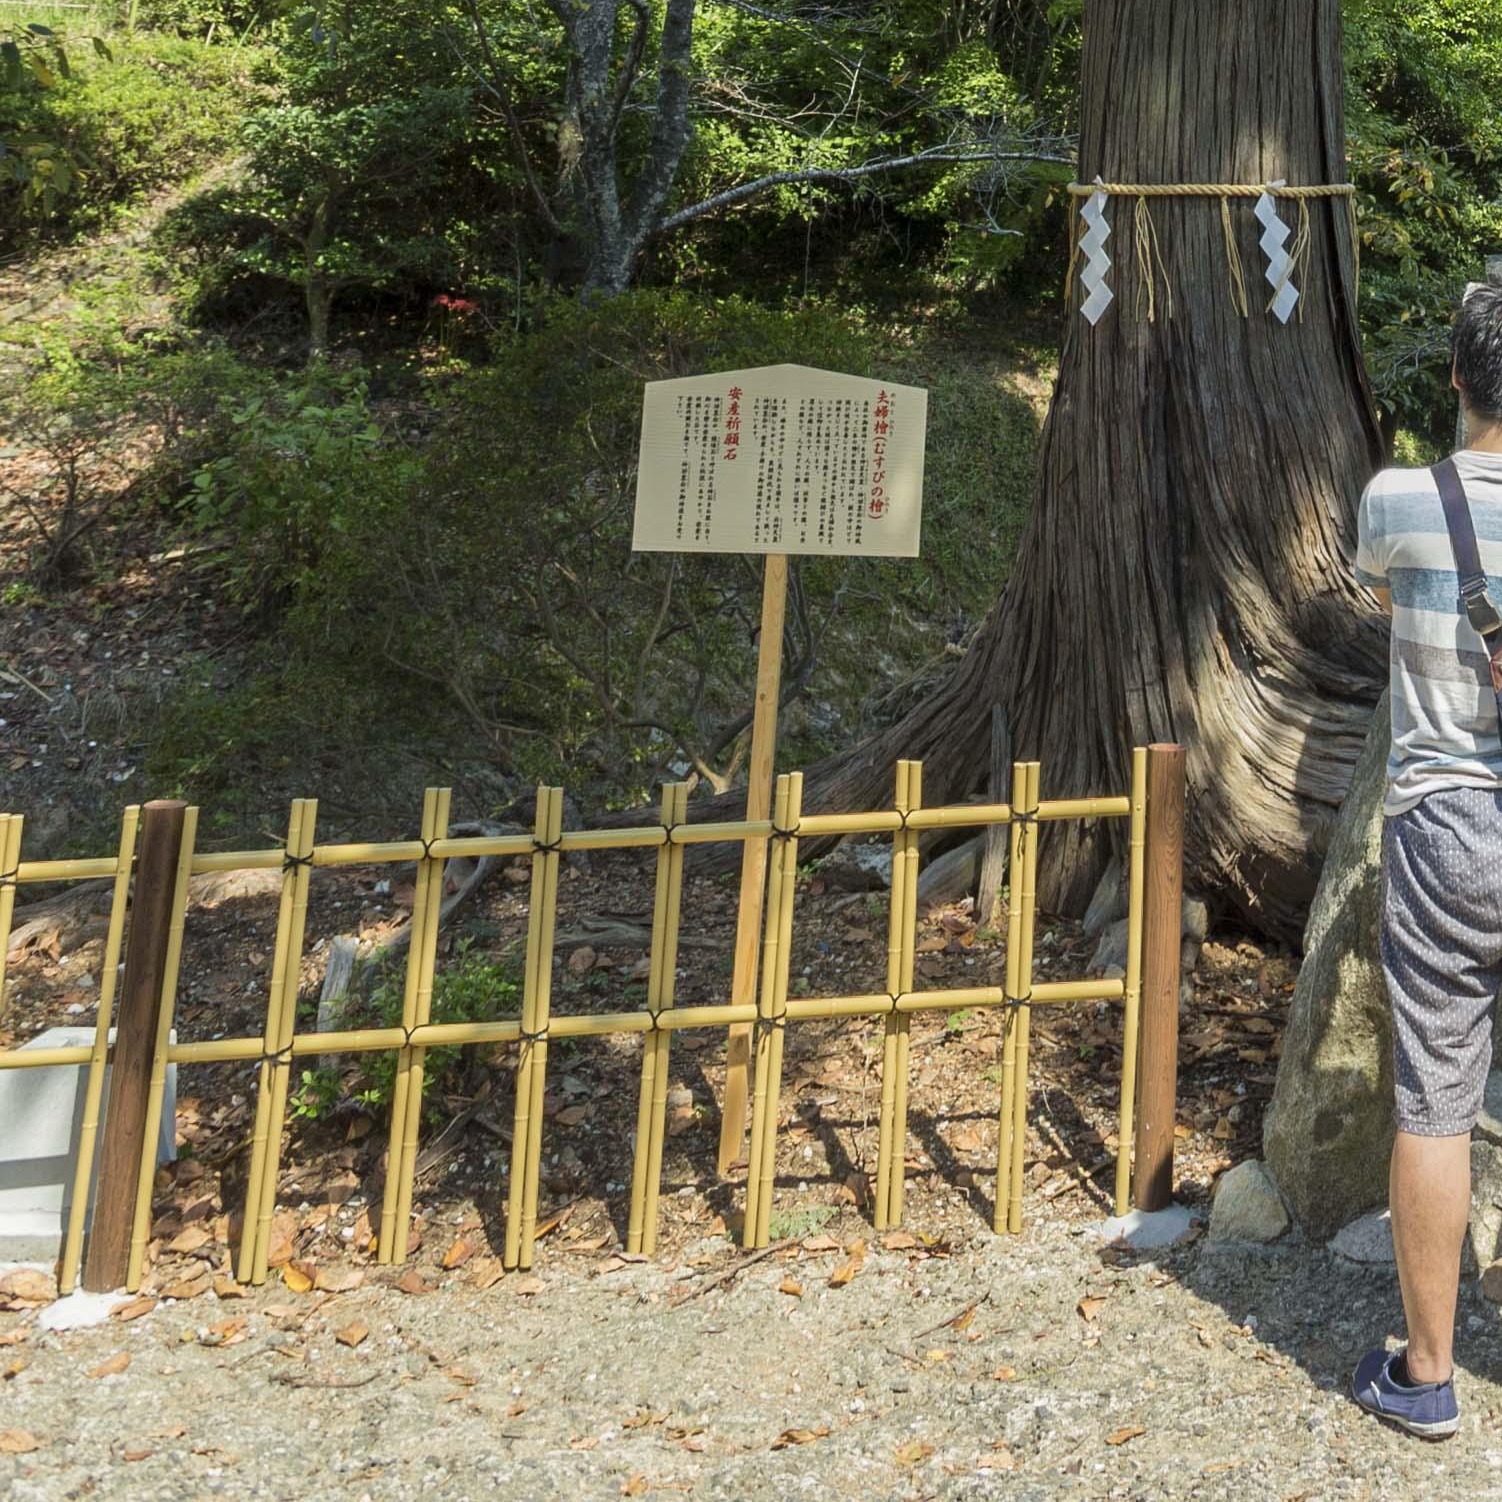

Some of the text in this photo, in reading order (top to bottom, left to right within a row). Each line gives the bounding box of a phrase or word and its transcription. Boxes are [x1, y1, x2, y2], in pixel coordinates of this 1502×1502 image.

[723, 386, 743, 460] 安産祈願石
[868, 389, 889, 519] 夫婦檜(むすびの檜)
